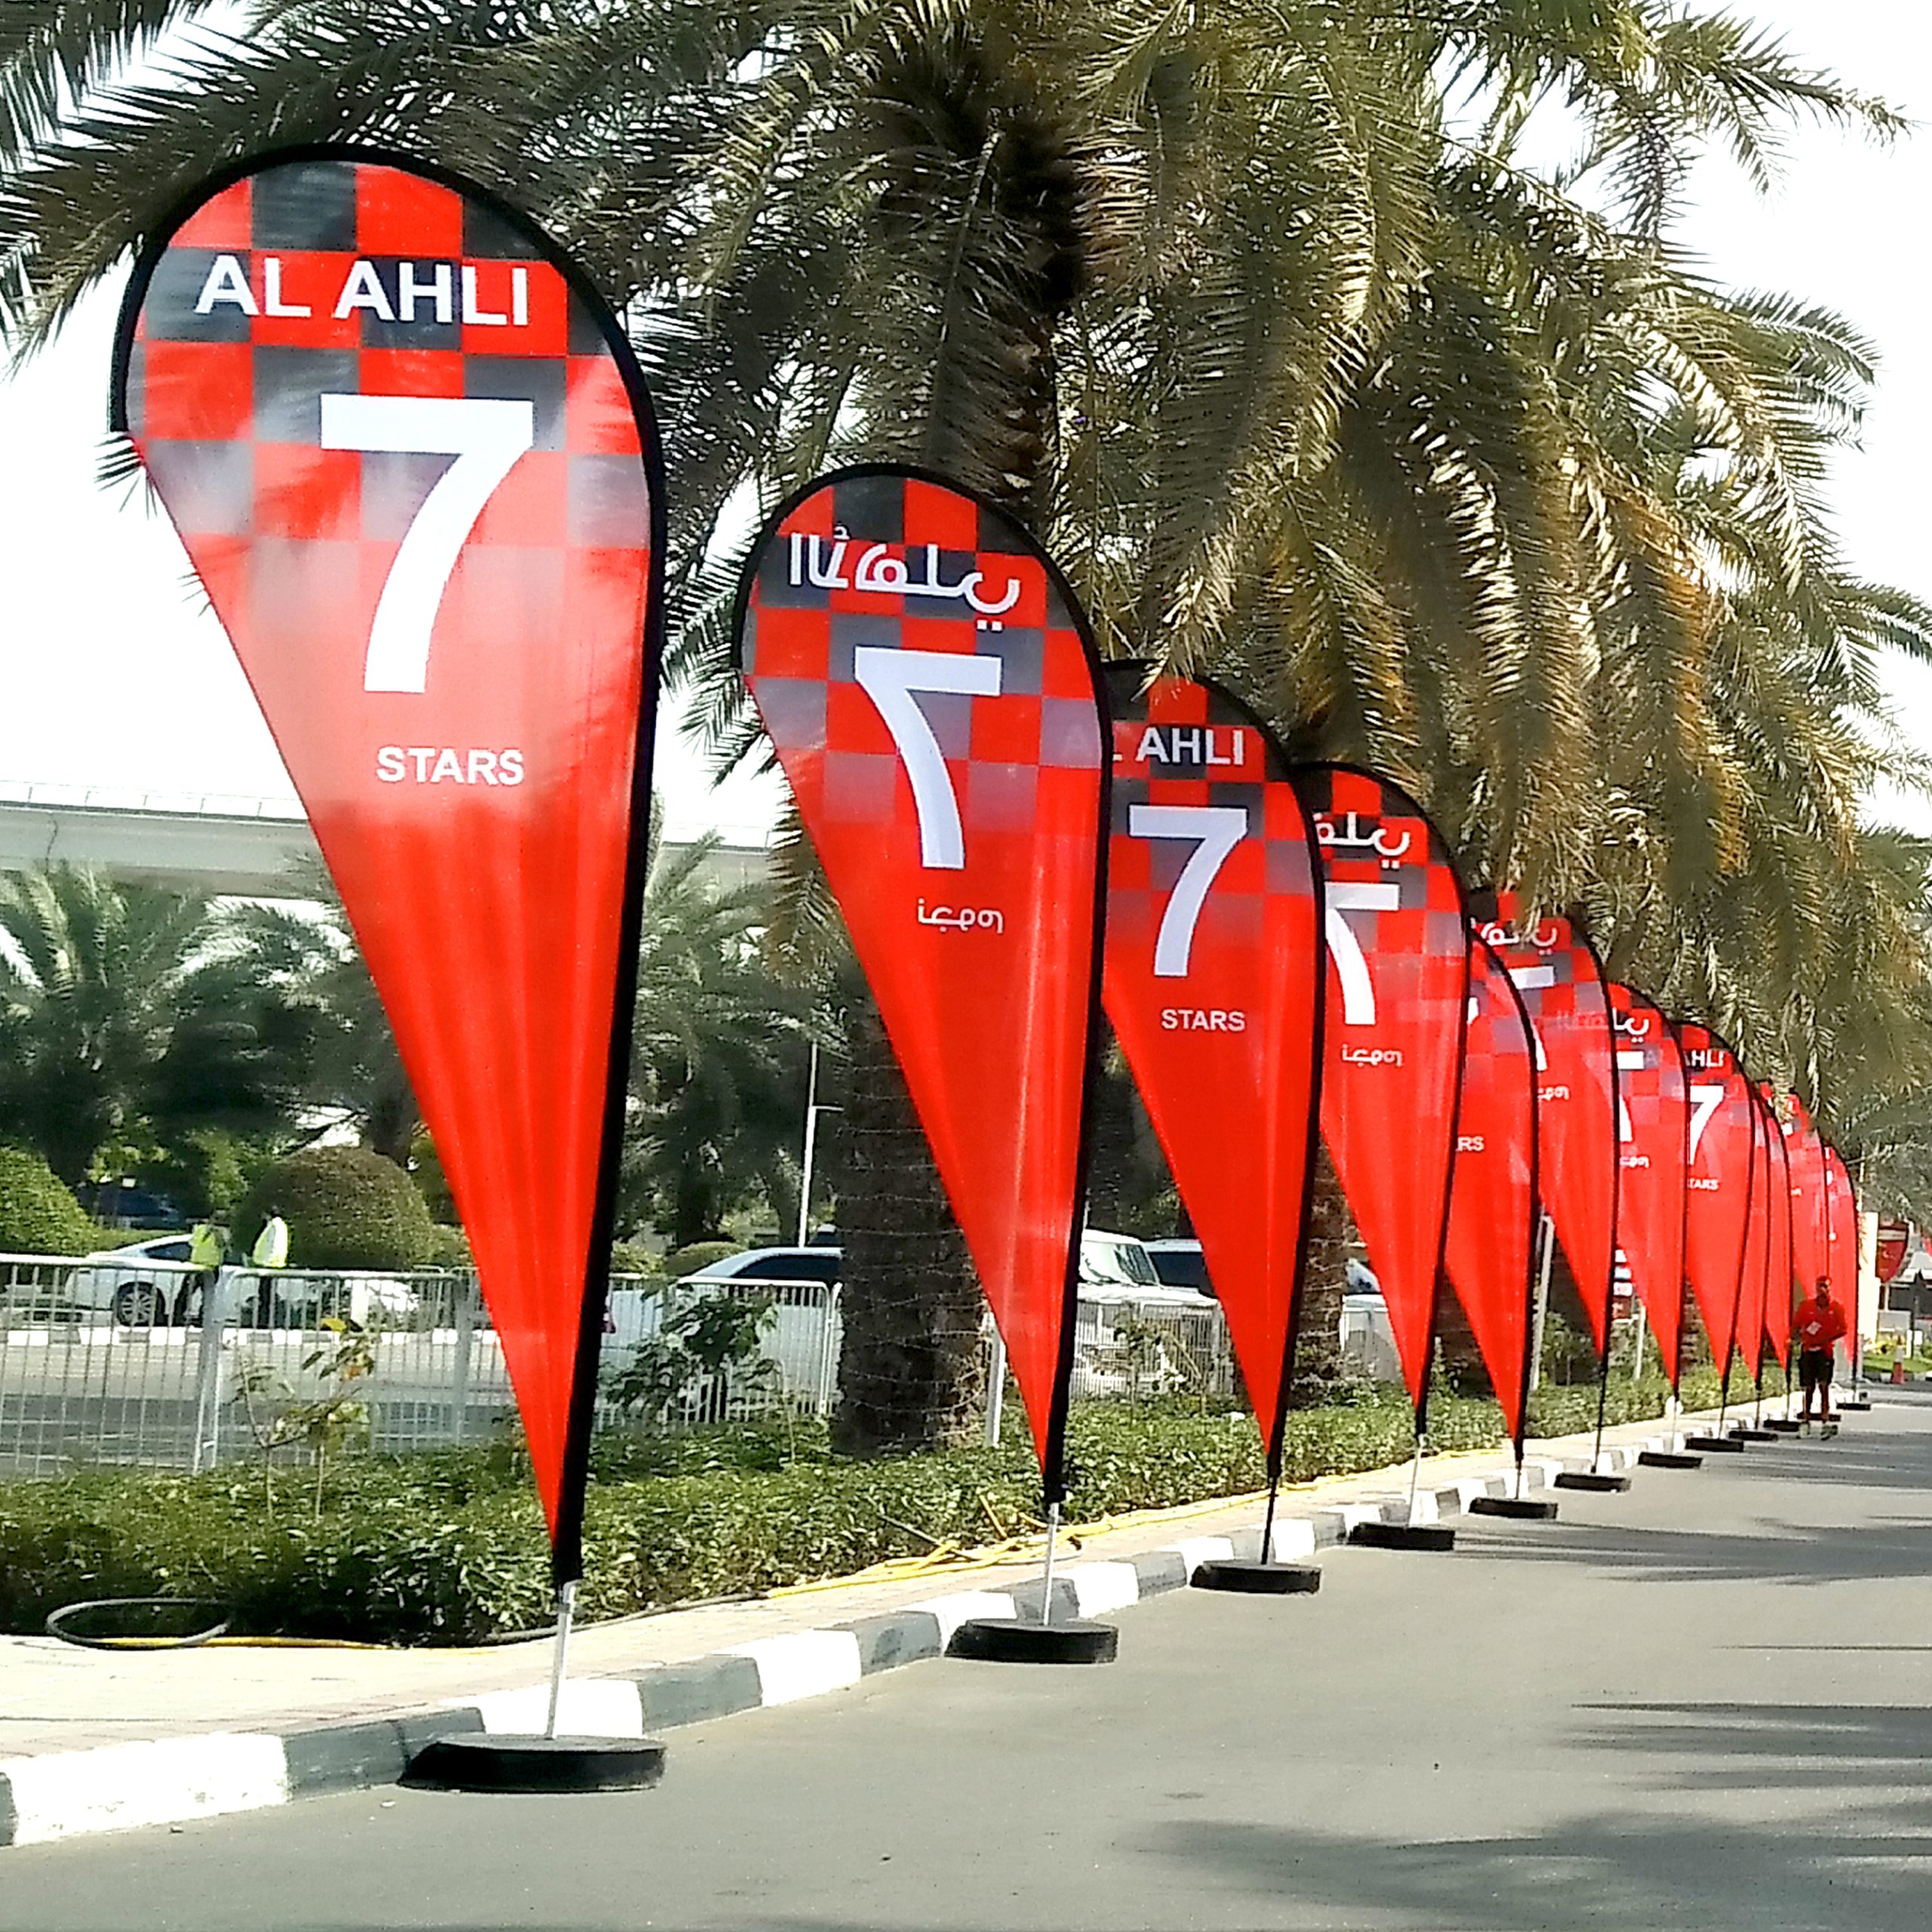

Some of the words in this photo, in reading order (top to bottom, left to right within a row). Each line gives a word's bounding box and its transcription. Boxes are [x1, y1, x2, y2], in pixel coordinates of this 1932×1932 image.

[195, 254, 312, 318] AL
[333, 260, 529, 326] AHLI
[321, 393, 534, 693] 7
[376, 746, 525, 786] STARS
[1136, 726, 1244, 766] AHLI
[1129, 804, 1247, 977] 7
[1161, 1008, 1245, 1032] STARS
[1690, 1085, 1724, 1166] 7
